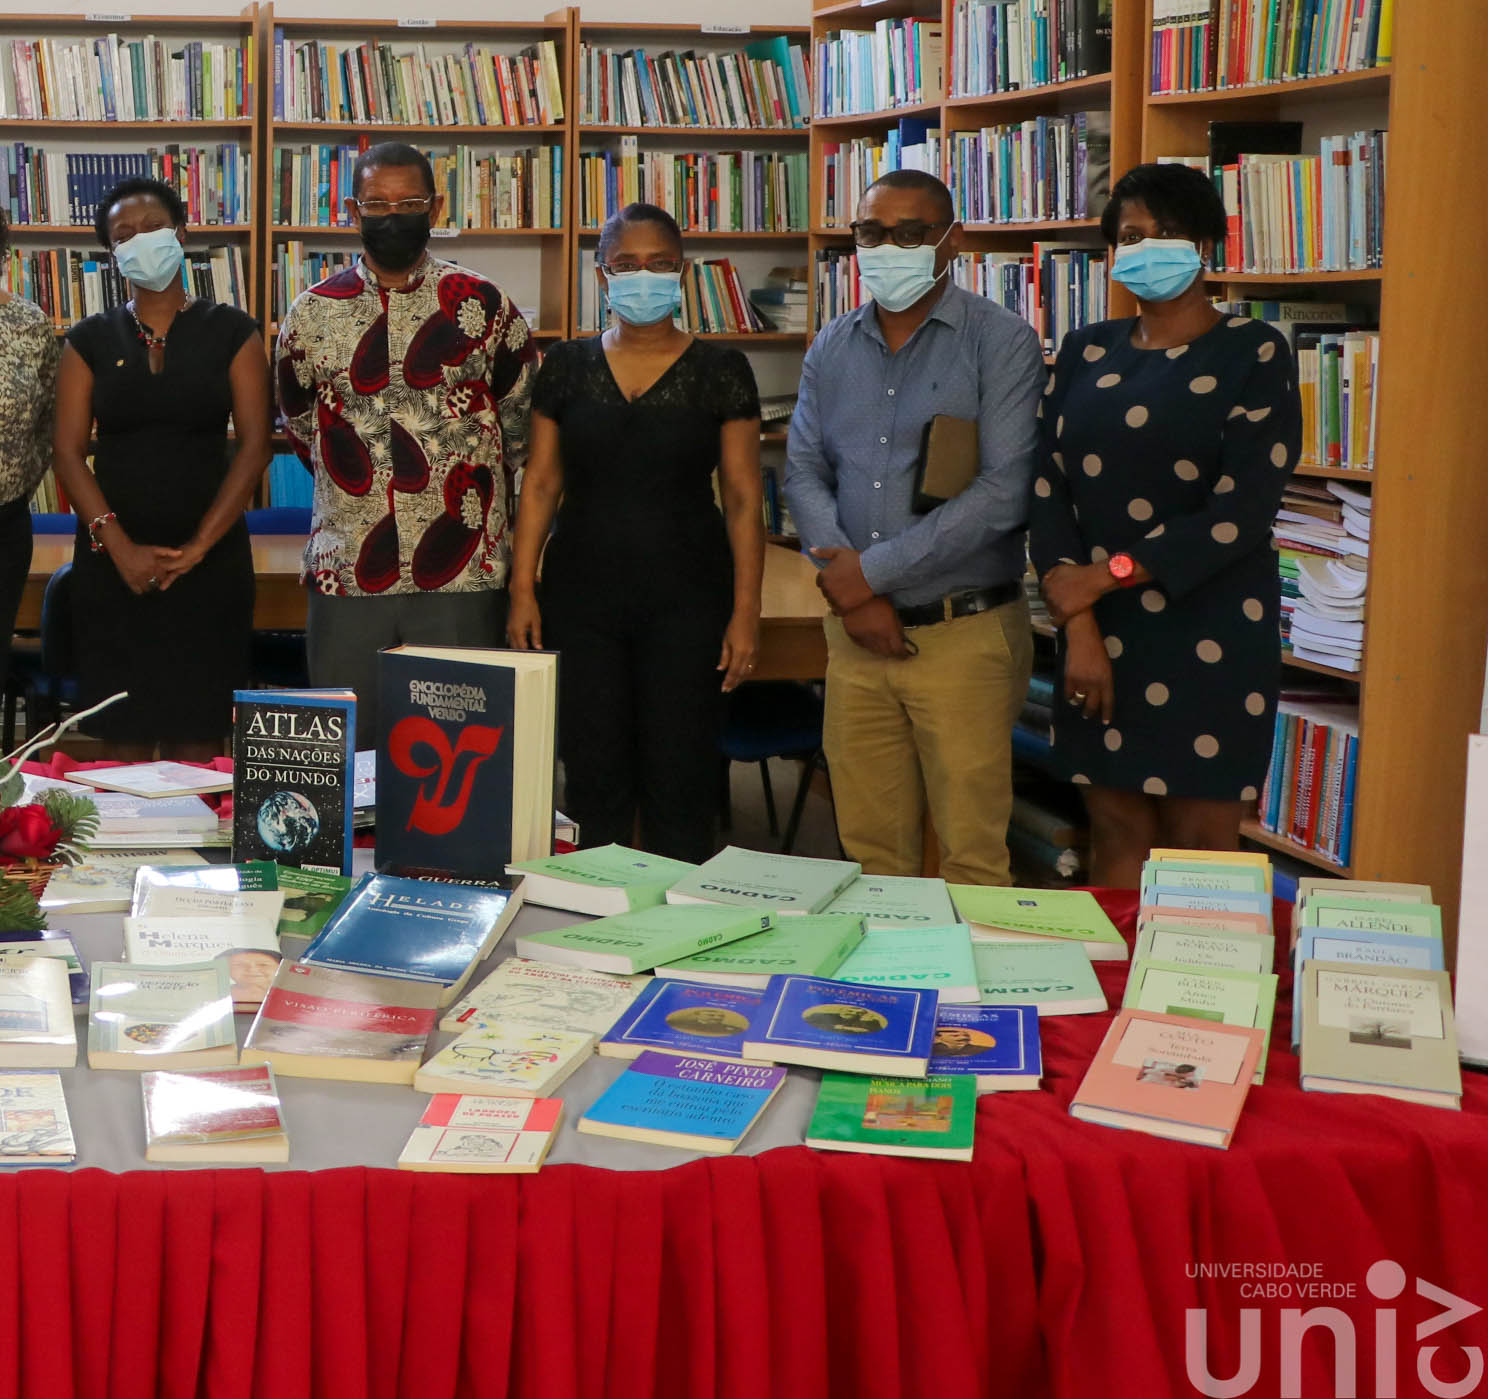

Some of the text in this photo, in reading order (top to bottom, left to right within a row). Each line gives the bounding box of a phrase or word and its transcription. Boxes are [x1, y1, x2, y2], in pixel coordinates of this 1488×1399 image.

[410, 693, 487, 714] FUNDAMENTAL
[246, 712, 343, 741] ATLAS
[247, 745, 341, 765] DAS NAÇÕES
[246, 767, 271, 781] DO
[700, 883, 798, 901] CADMO
[1336, 919, 1415, 934] ALLENDE
[139, 931, 210, 941] Helena
[562, 932, 645, 948] CADMO
[697, 933, 724, 947] CADMO
[148, 938, 235, 950] Marques
[691, 954, 798, 966] CADMO
[837, 971, 952, 984] CADMO
[983, 984, 1075, 996] CADM
[675, 1057, 773, 1078] JOSÉ PINTO
[678, 1069, 766, 1088] CARNEIRO
